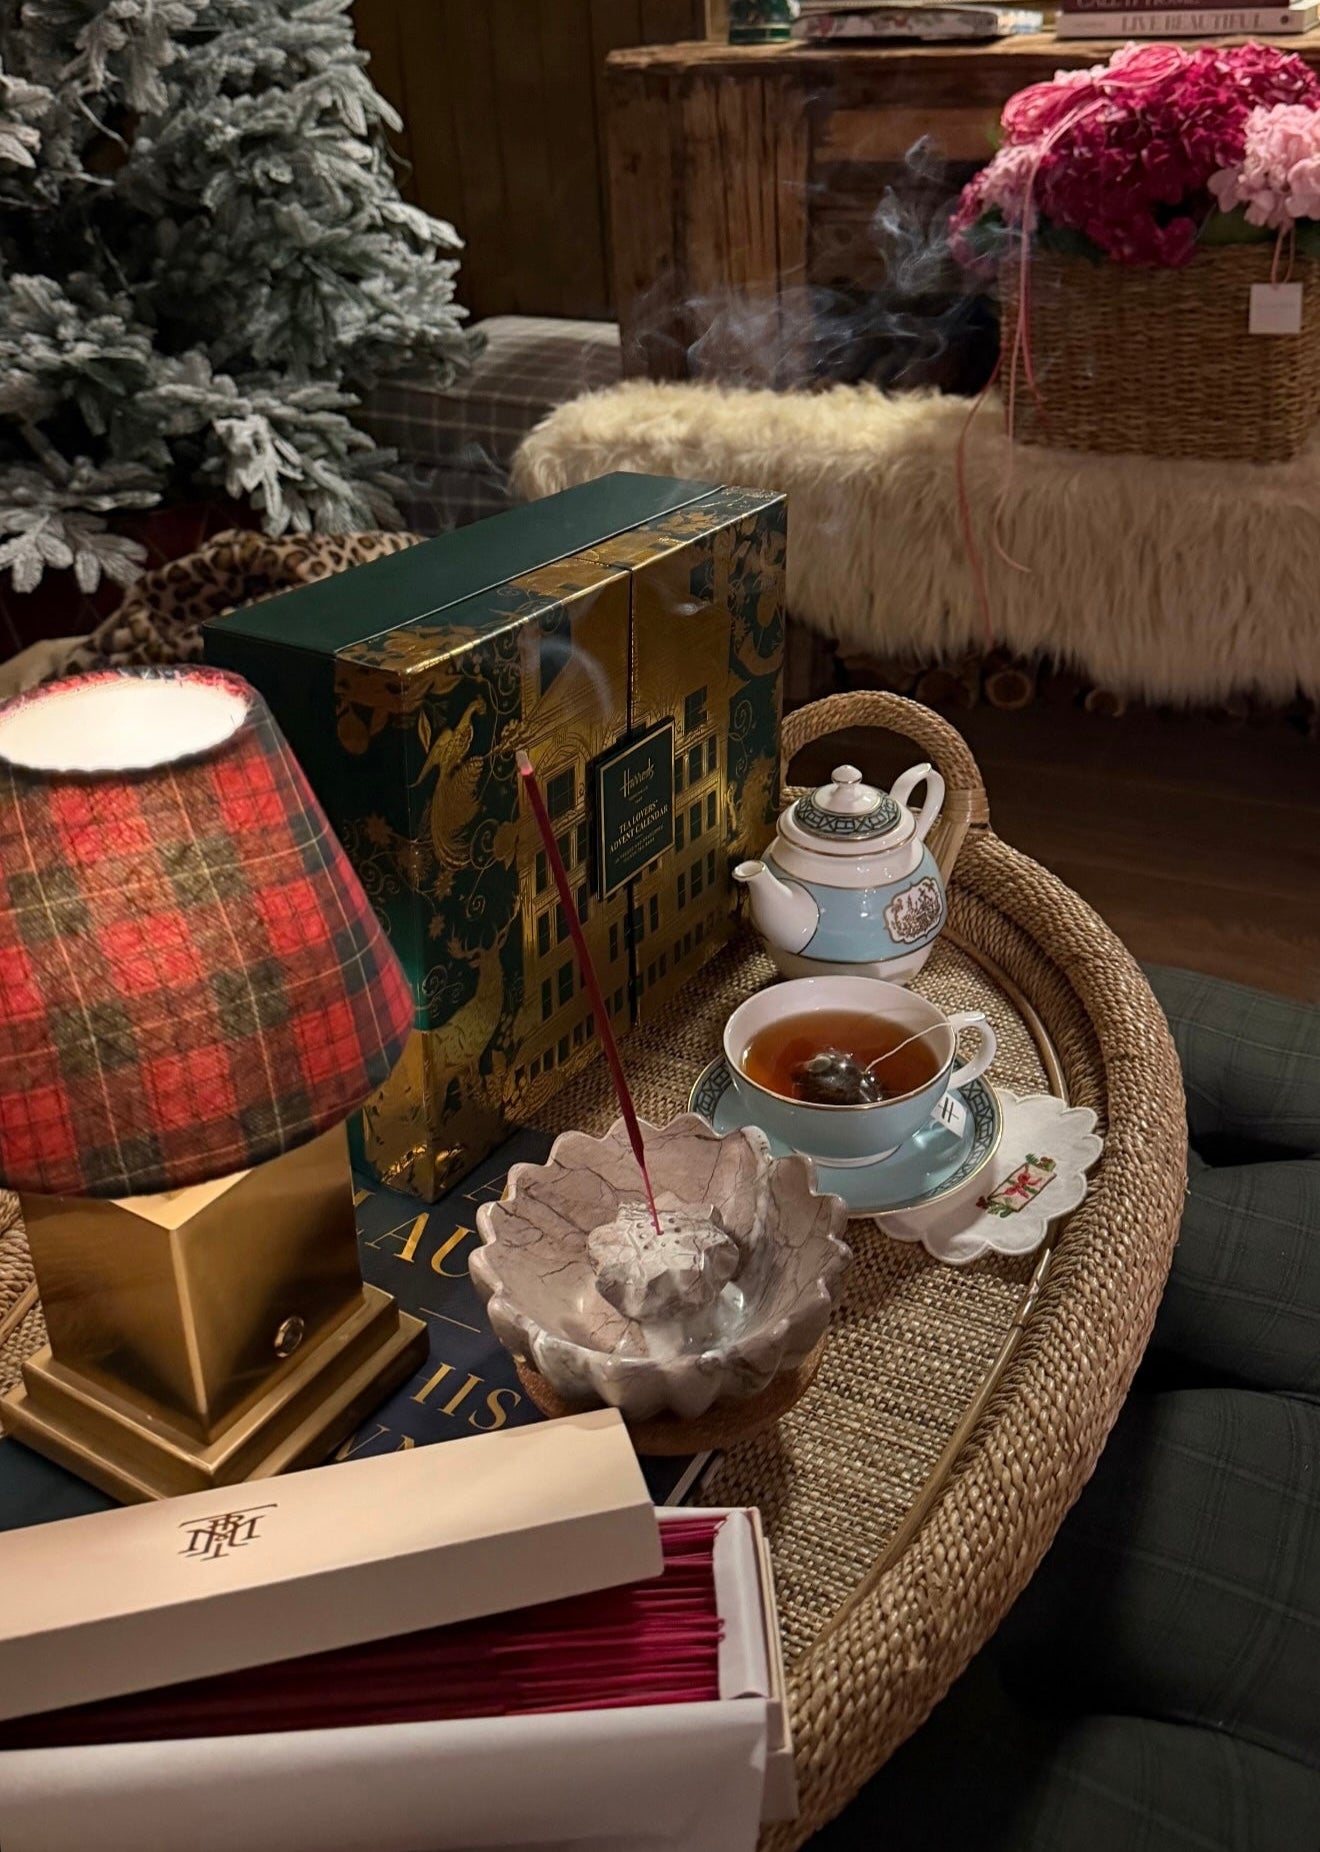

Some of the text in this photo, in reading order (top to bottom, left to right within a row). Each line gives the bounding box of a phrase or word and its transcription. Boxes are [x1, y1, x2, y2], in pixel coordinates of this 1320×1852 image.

[1121, 12, 1264, 32] LIVE BEAUTIFUL
[619, 757, 655, 798] Harrods
[610, 828, 634, 854] ADVENT
[635, 803, 668, 834] CALENDAR
[619, 819, 632, 834] TEA
